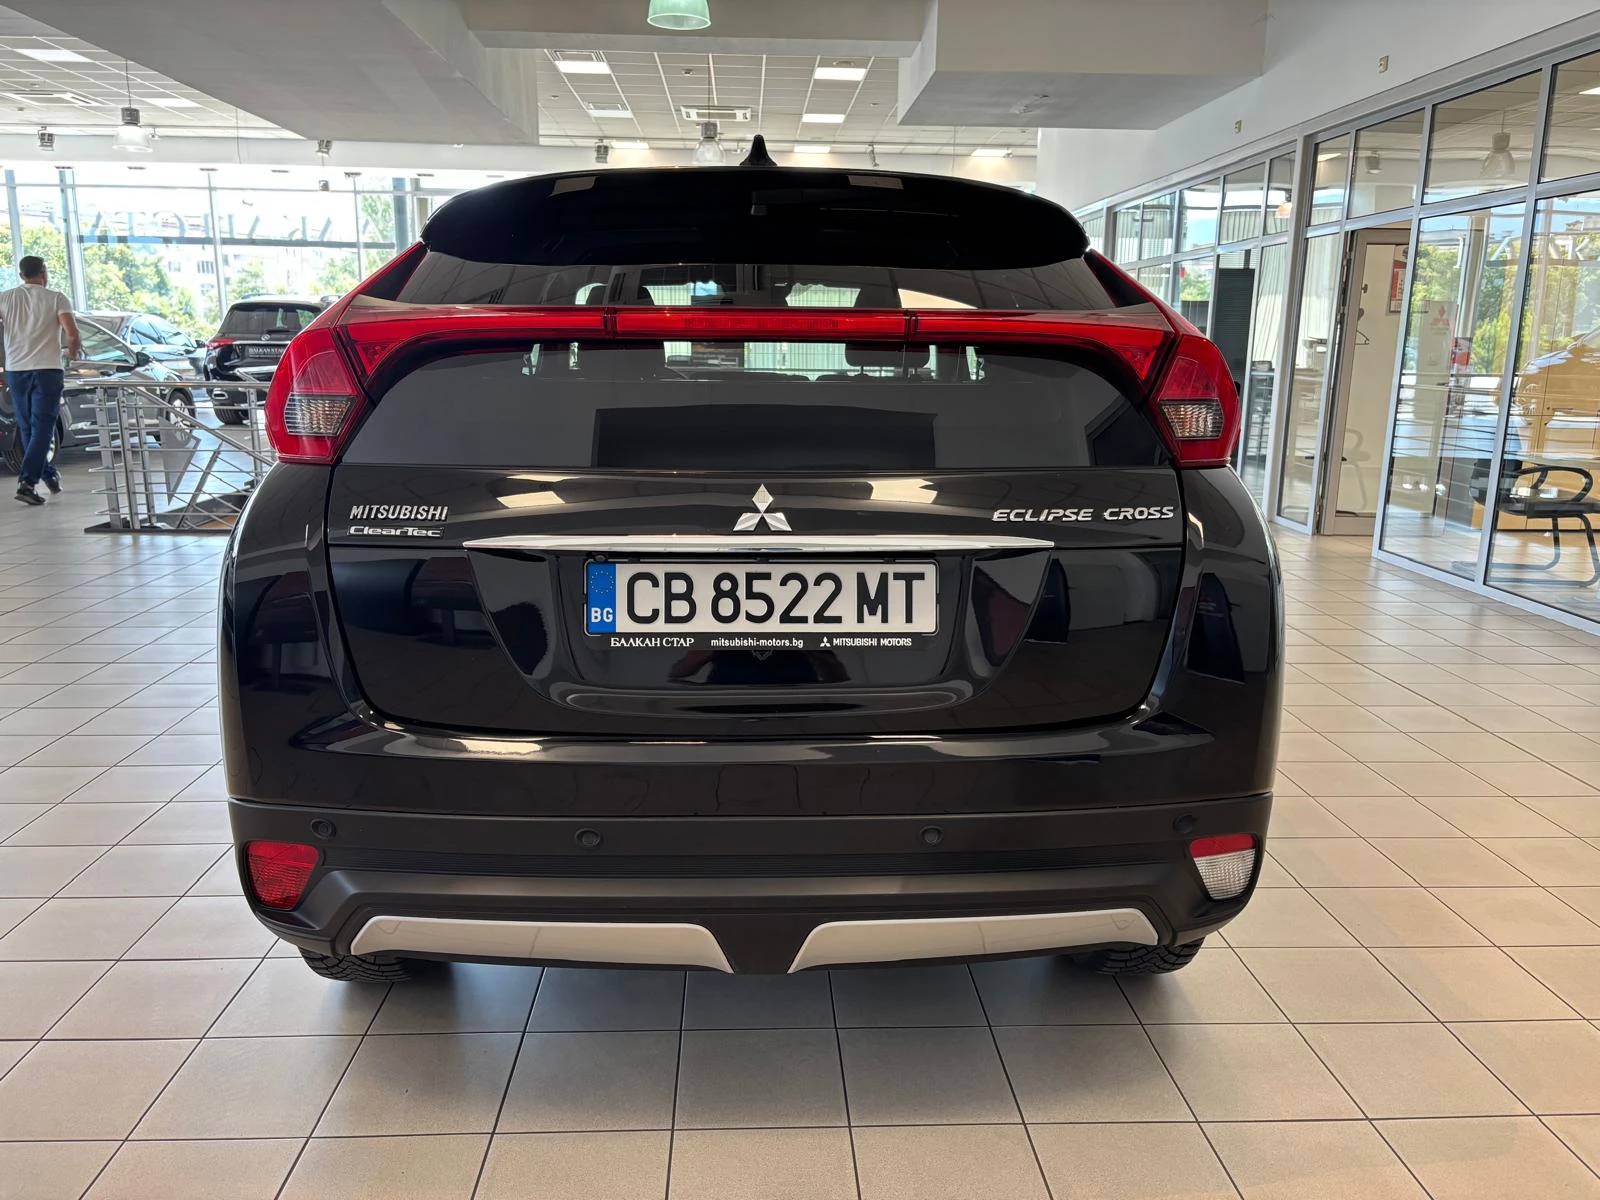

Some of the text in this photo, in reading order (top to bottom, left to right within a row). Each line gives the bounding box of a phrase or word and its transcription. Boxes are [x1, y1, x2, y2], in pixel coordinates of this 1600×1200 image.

[349, 504, 449, 520] MITSUBISHI
[992, 506, 1174, 522] ECLIPSE CROSS
[349, 525, 441, 537] ClearTec
[626, 571, 926, 625] CB 8522 MT
[590, 607, 613, 623] BG
[610, 637, 695, 647] БАЛКАН СТАР
[710, 636, 804, 649] mitsubishi-motors.bg
[832, 637, 912, 647] MITSUBISHI MOTORS
